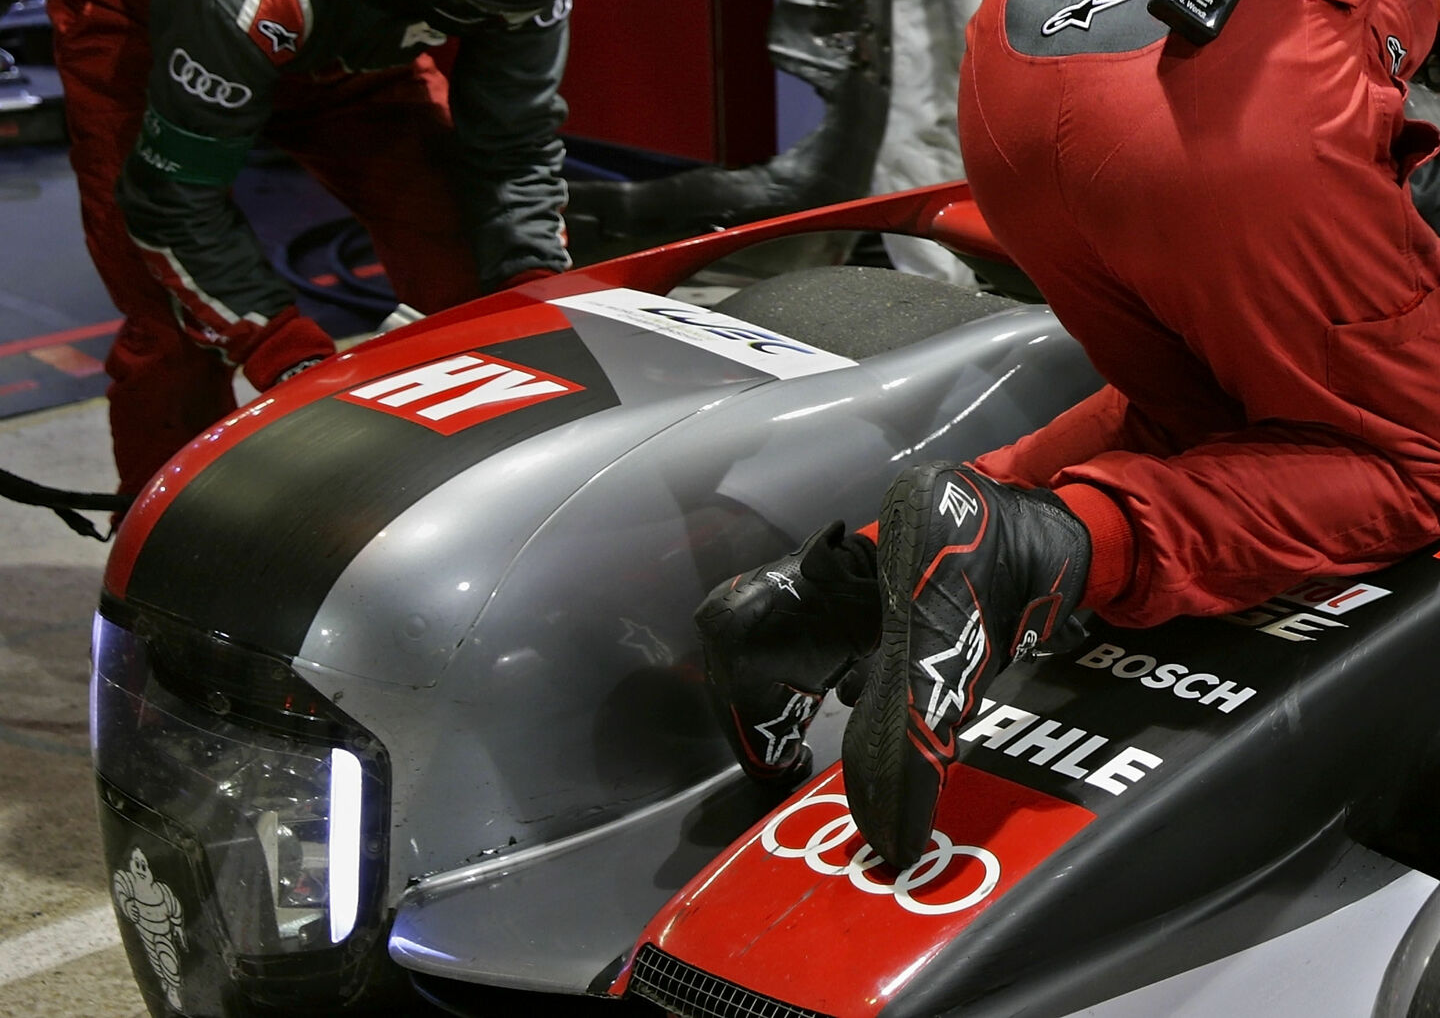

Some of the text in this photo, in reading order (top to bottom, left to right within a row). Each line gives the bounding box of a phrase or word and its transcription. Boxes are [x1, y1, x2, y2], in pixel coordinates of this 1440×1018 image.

[349, 354, 569, 422] HY
[1075, 642, 1257, 714] BOSCH
[959, 697, 1164, 796] AHLE
